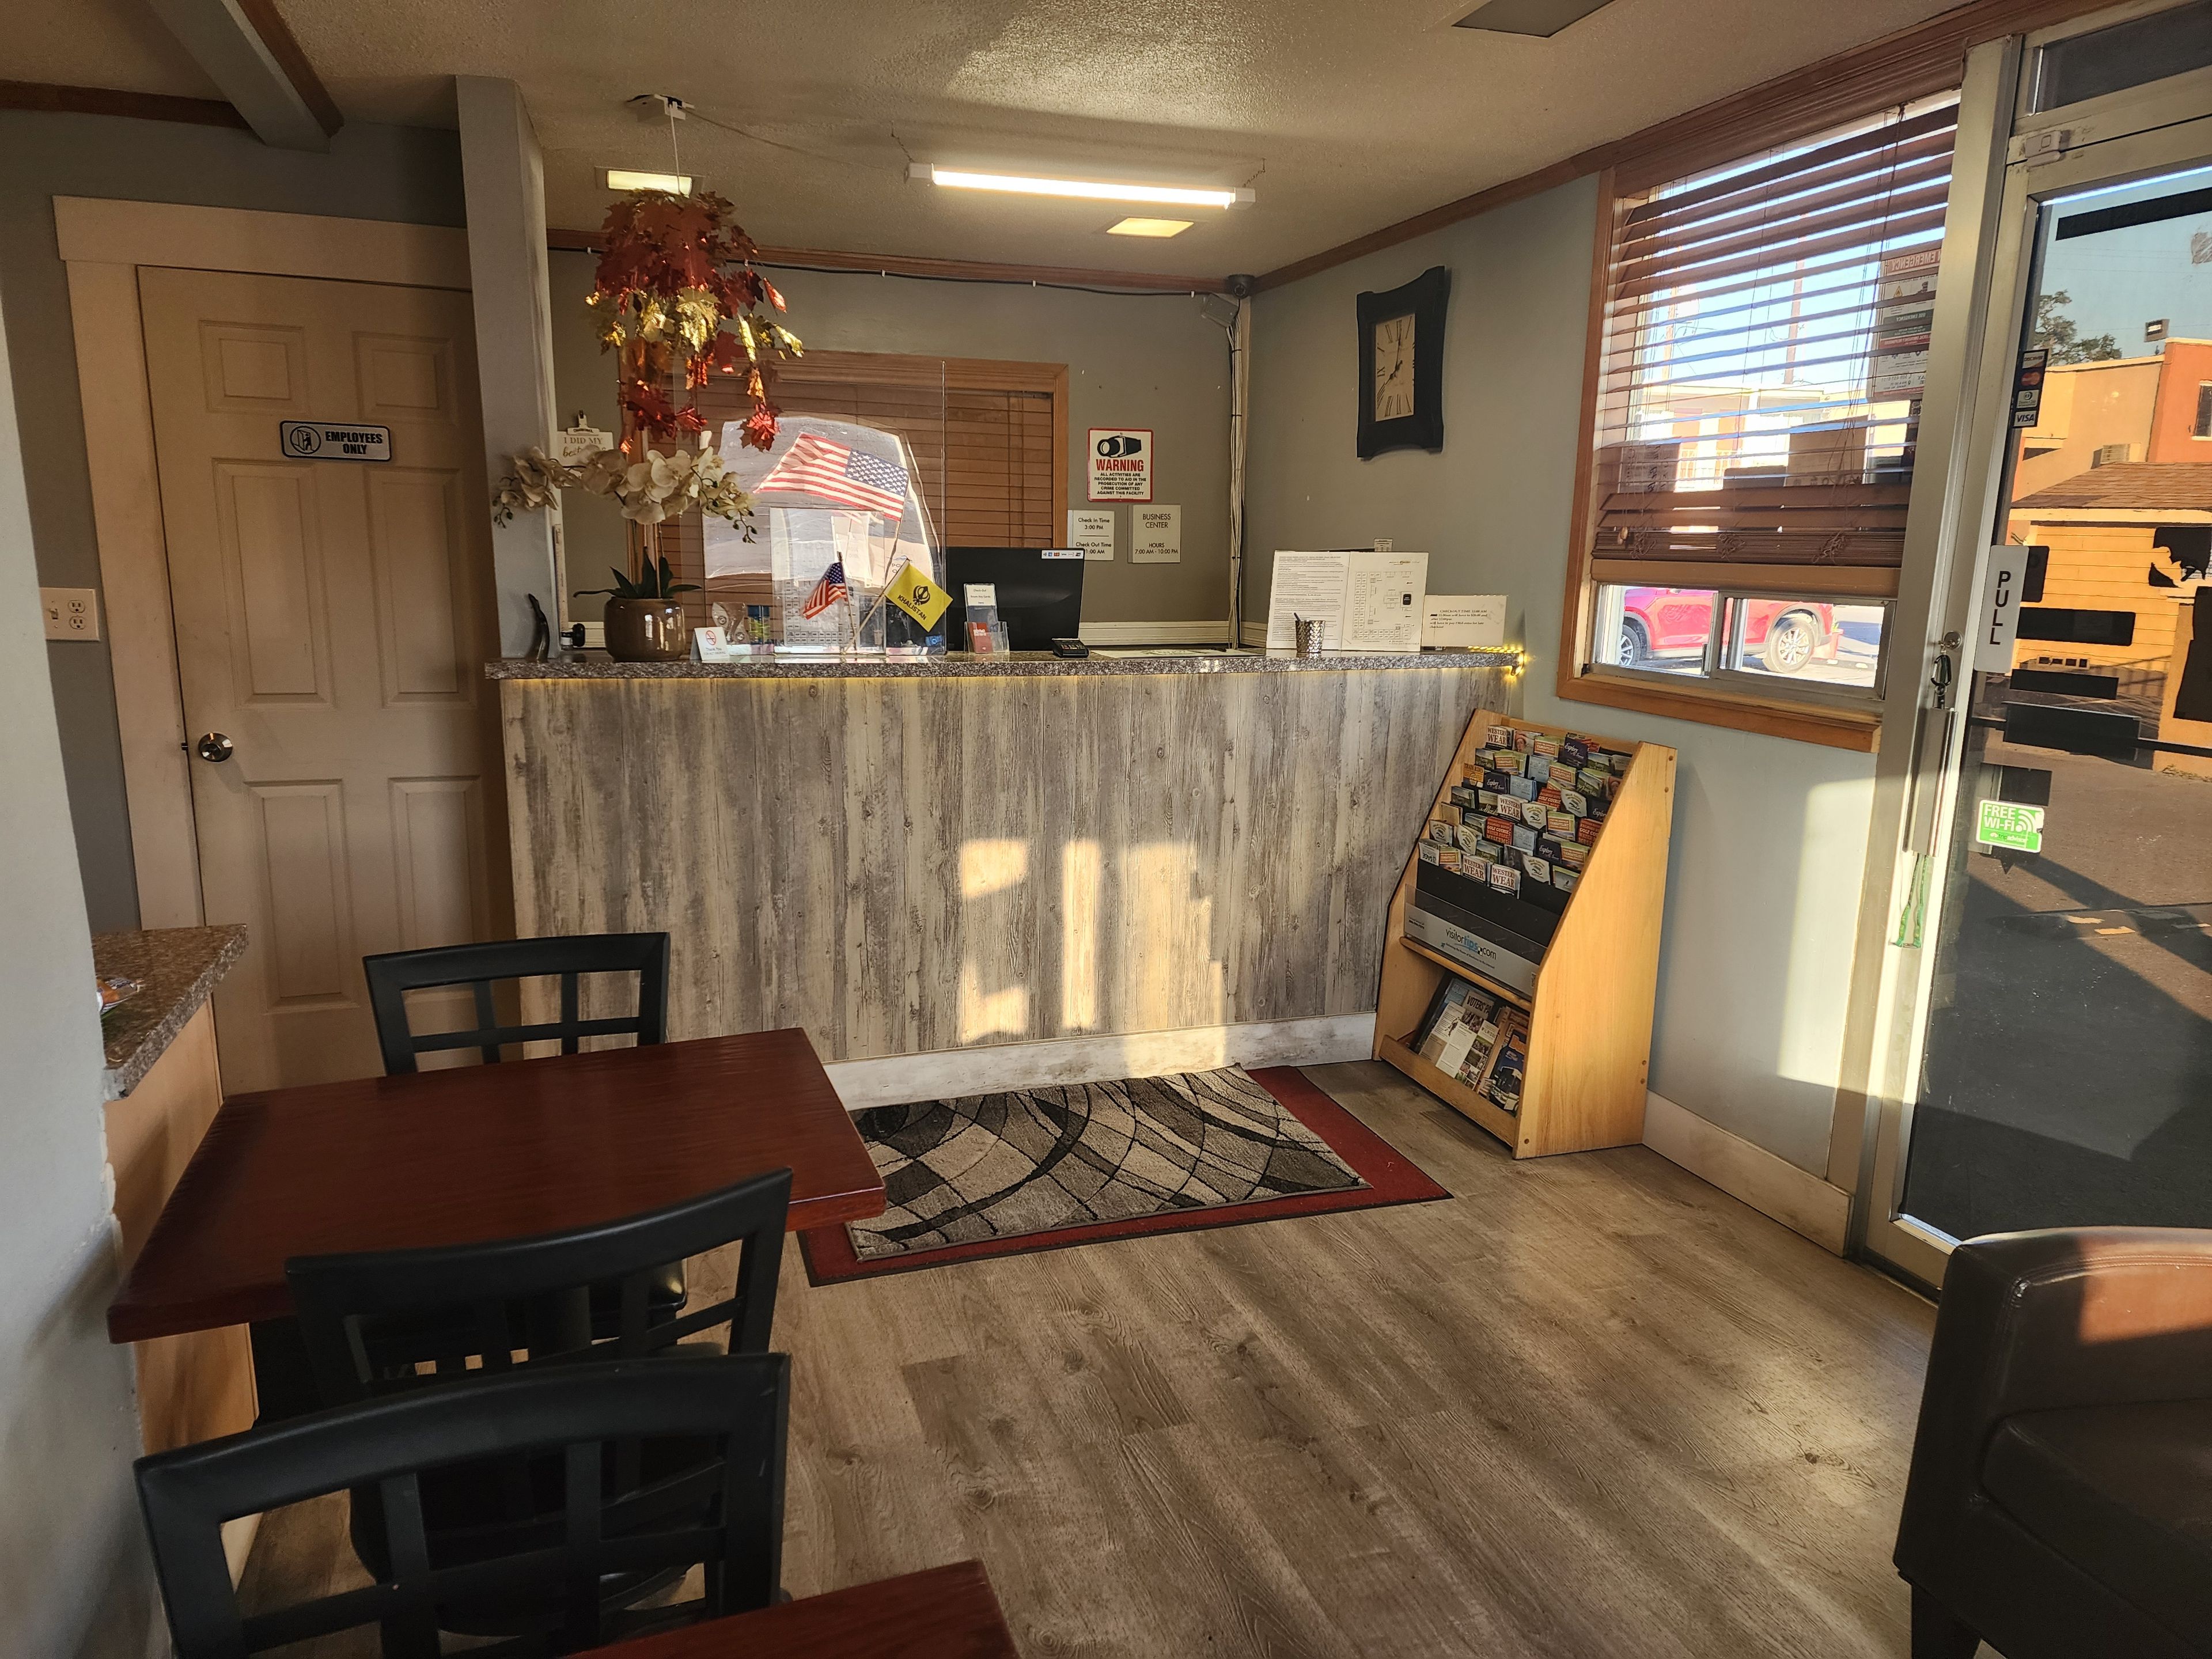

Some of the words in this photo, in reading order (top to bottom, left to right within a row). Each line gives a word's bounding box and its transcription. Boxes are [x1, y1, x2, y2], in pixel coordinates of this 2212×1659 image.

[2017, 414, 2035, 422] VISA
[325, 431, 382, 444] EMPLOYEES
[343, 444, 368, 454] ONLY
[1096, 459, 1144, 471] WARNING
[897, 594, 926, 620] KHALISTAN
[1990, 571, 2011, 645] PULL
[1487, 733, 1506, 745] WEAR
[1500, 804, 1520, 818] WEAR
[1984, 804, 2016, 820] FREE
[1984, 816, 2015, 832] WI-FI
[1464, 864, 1484, 879] WEAR
[1493, 874, 1514, 888] WEAR
